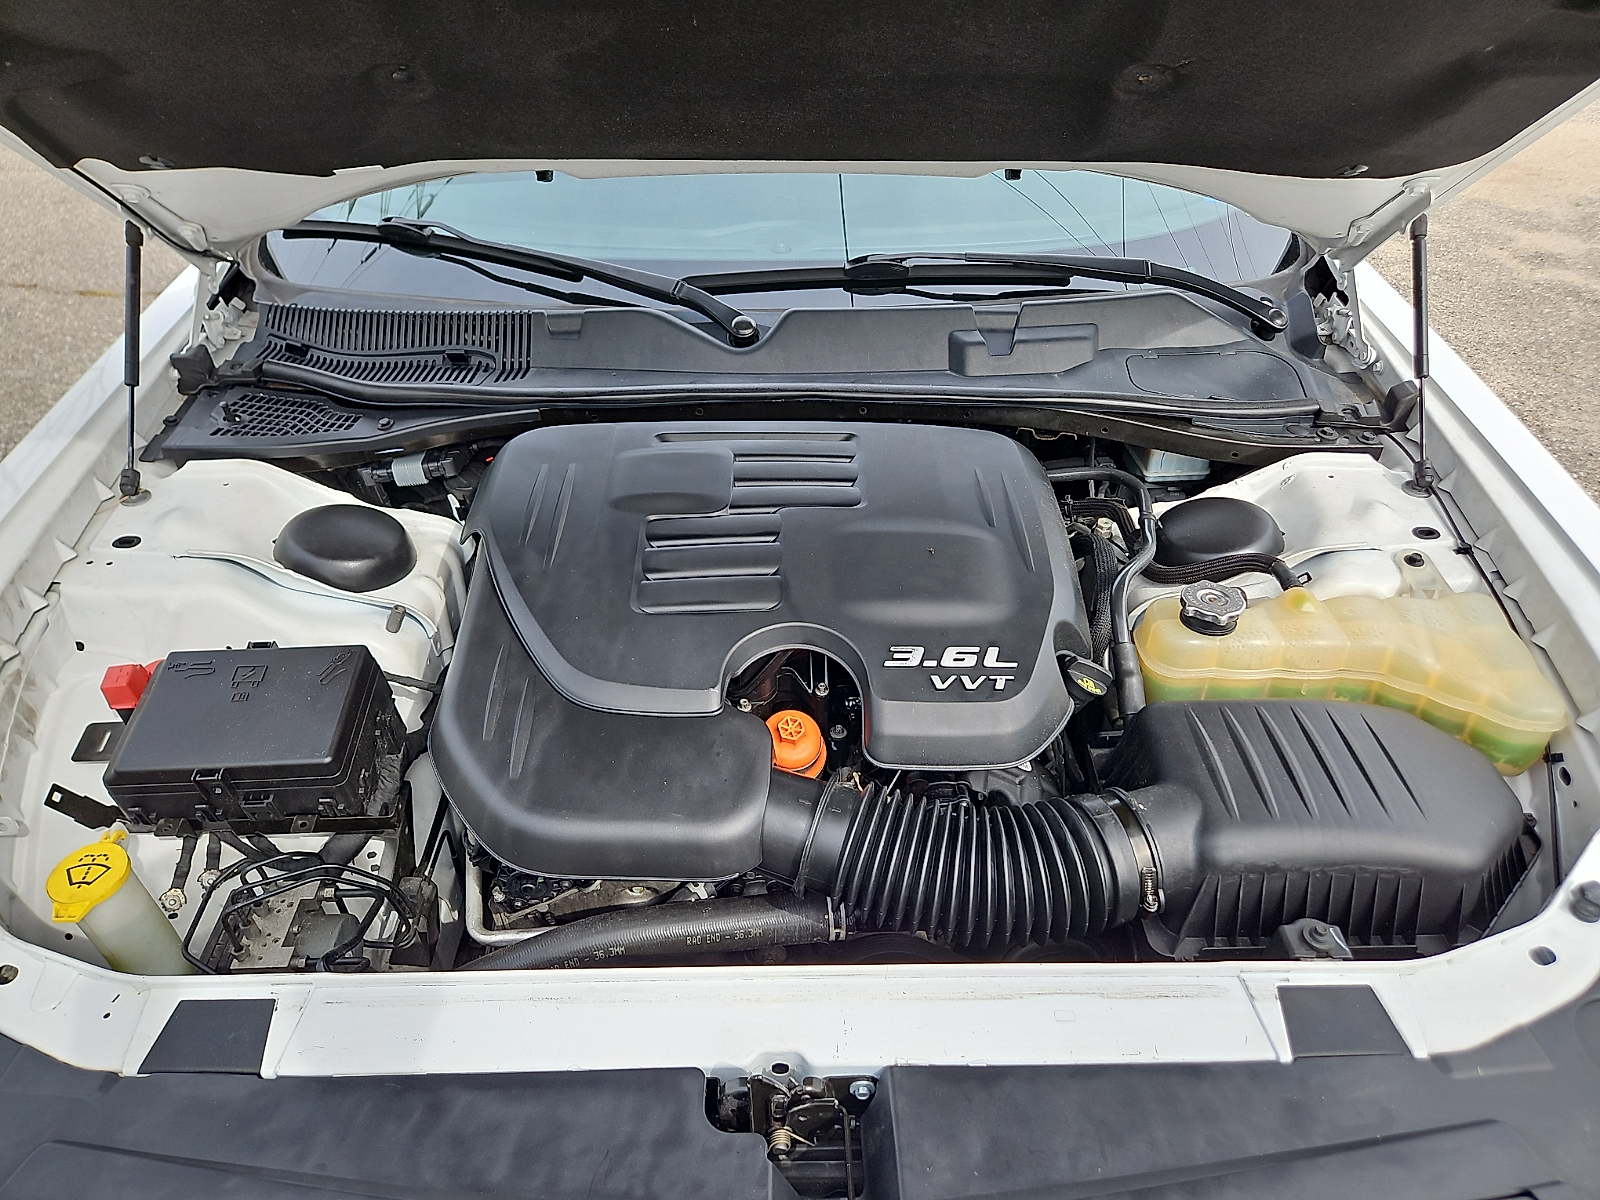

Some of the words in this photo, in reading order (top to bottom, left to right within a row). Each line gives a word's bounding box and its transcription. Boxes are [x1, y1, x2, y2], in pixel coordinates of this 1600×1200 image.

[883, 646, 1018, 668] 3.6L
[929, 675, 1015, 690] VVT
[686, 936, 702, 946] RAD
[706, 932, 721, 944] END
[734, 929, 763, 940] 36.3MM
[564, 957, 580, 969] END
[593, 946, 626, 961] 36.3MM
